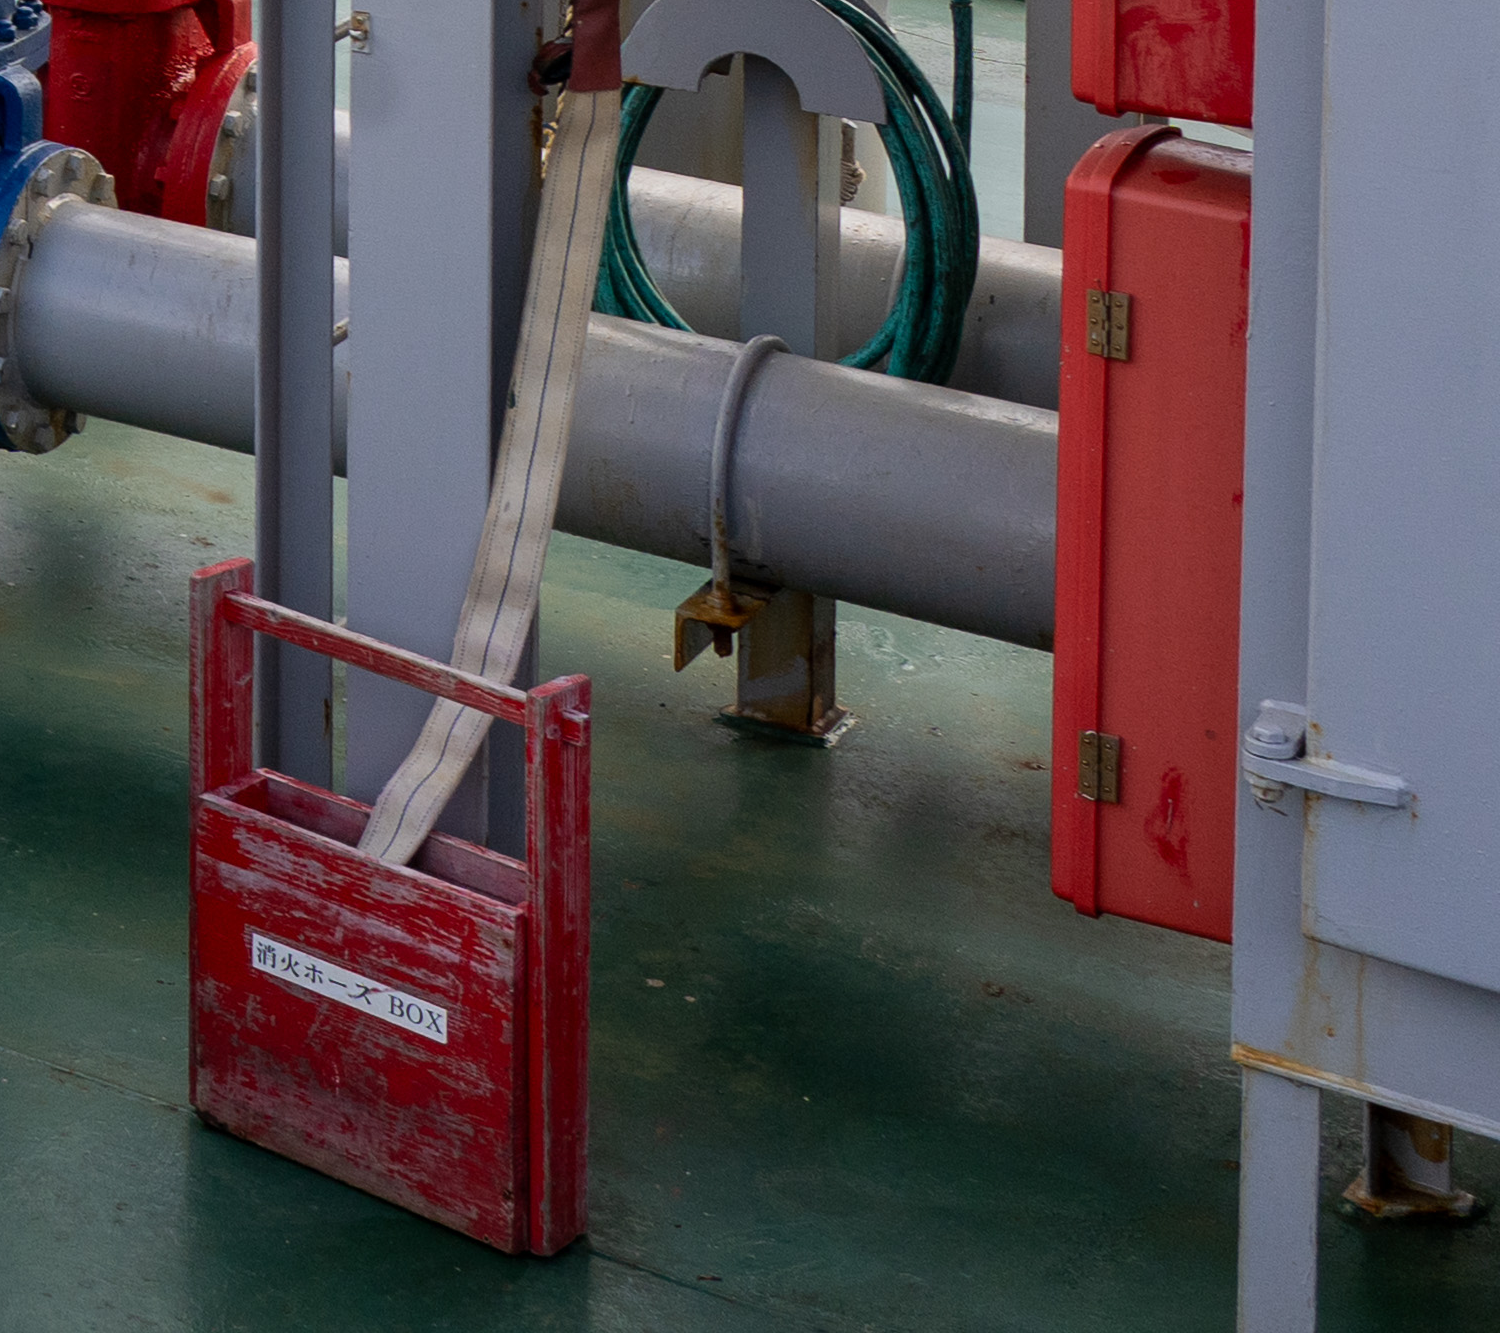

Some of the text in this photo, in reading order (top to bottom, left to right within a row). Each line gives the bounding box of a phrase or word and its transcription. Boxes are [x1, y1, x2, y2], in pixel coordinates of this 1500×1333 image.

[256, 941, 444, 1034] 消火ホース BOX
